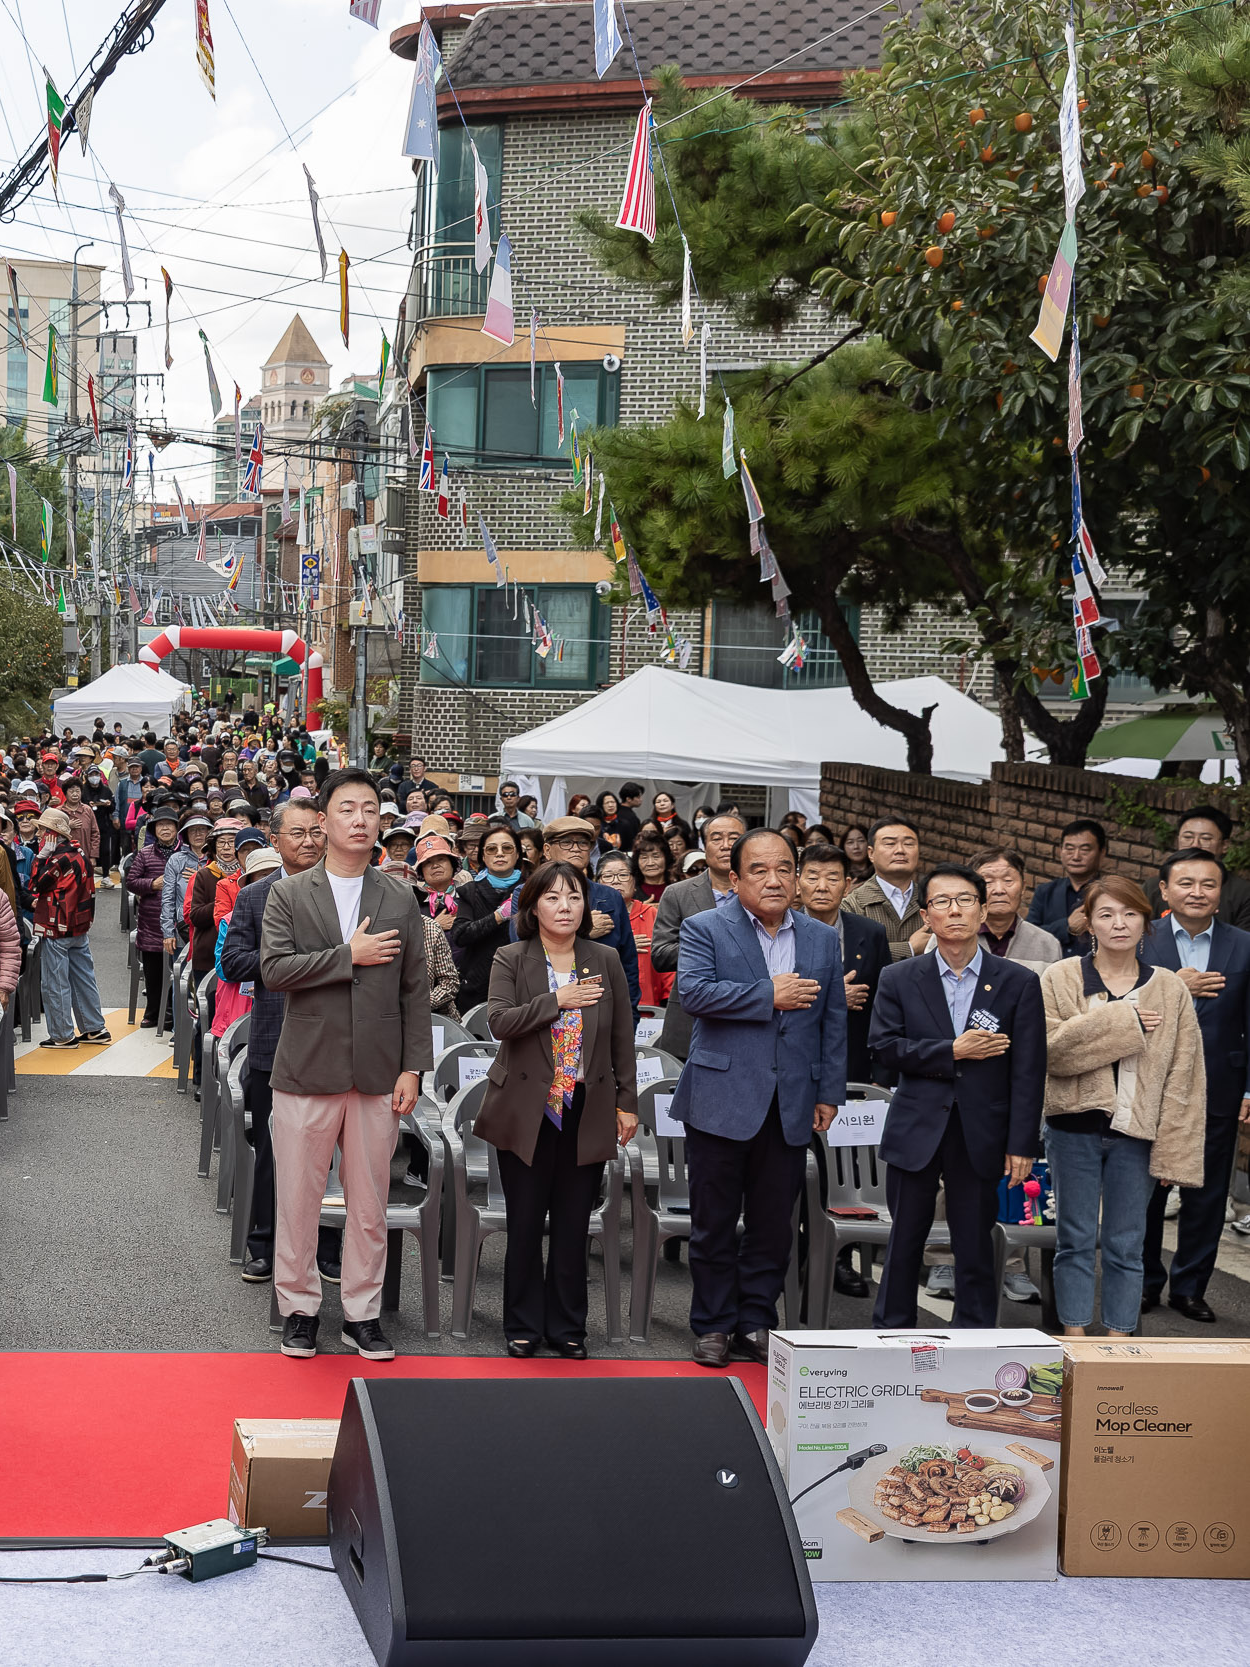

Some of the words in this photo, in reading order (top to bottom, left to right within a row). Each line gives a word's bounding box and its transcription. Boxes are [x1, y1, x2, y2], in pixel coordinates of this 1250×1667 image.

[635, 1030, 656, 1038] 의원
[838, 1115, 875, 1126] 시의원
[799, 1366, 848, 1377] everyving
[799, 1386, 869, 1399] ELECTRIC
[871, 1384, 924, 1397] GRIDLE
[798, 1400, 832, 1410] 에브리빙
[833, 1400, 850, 1409] 전기
[850, 1399, 875, 1409] 그리들
[1096, 1402, 1159, 1415] Cordless
[1096, 1419, 1130, 1434] Mop
[1133, 1419, 1192, 1432] Cleaner
[1093, 1455, 1114, 1463] 물걸레
[1114, 1455, 1134, 1463] 청소기
